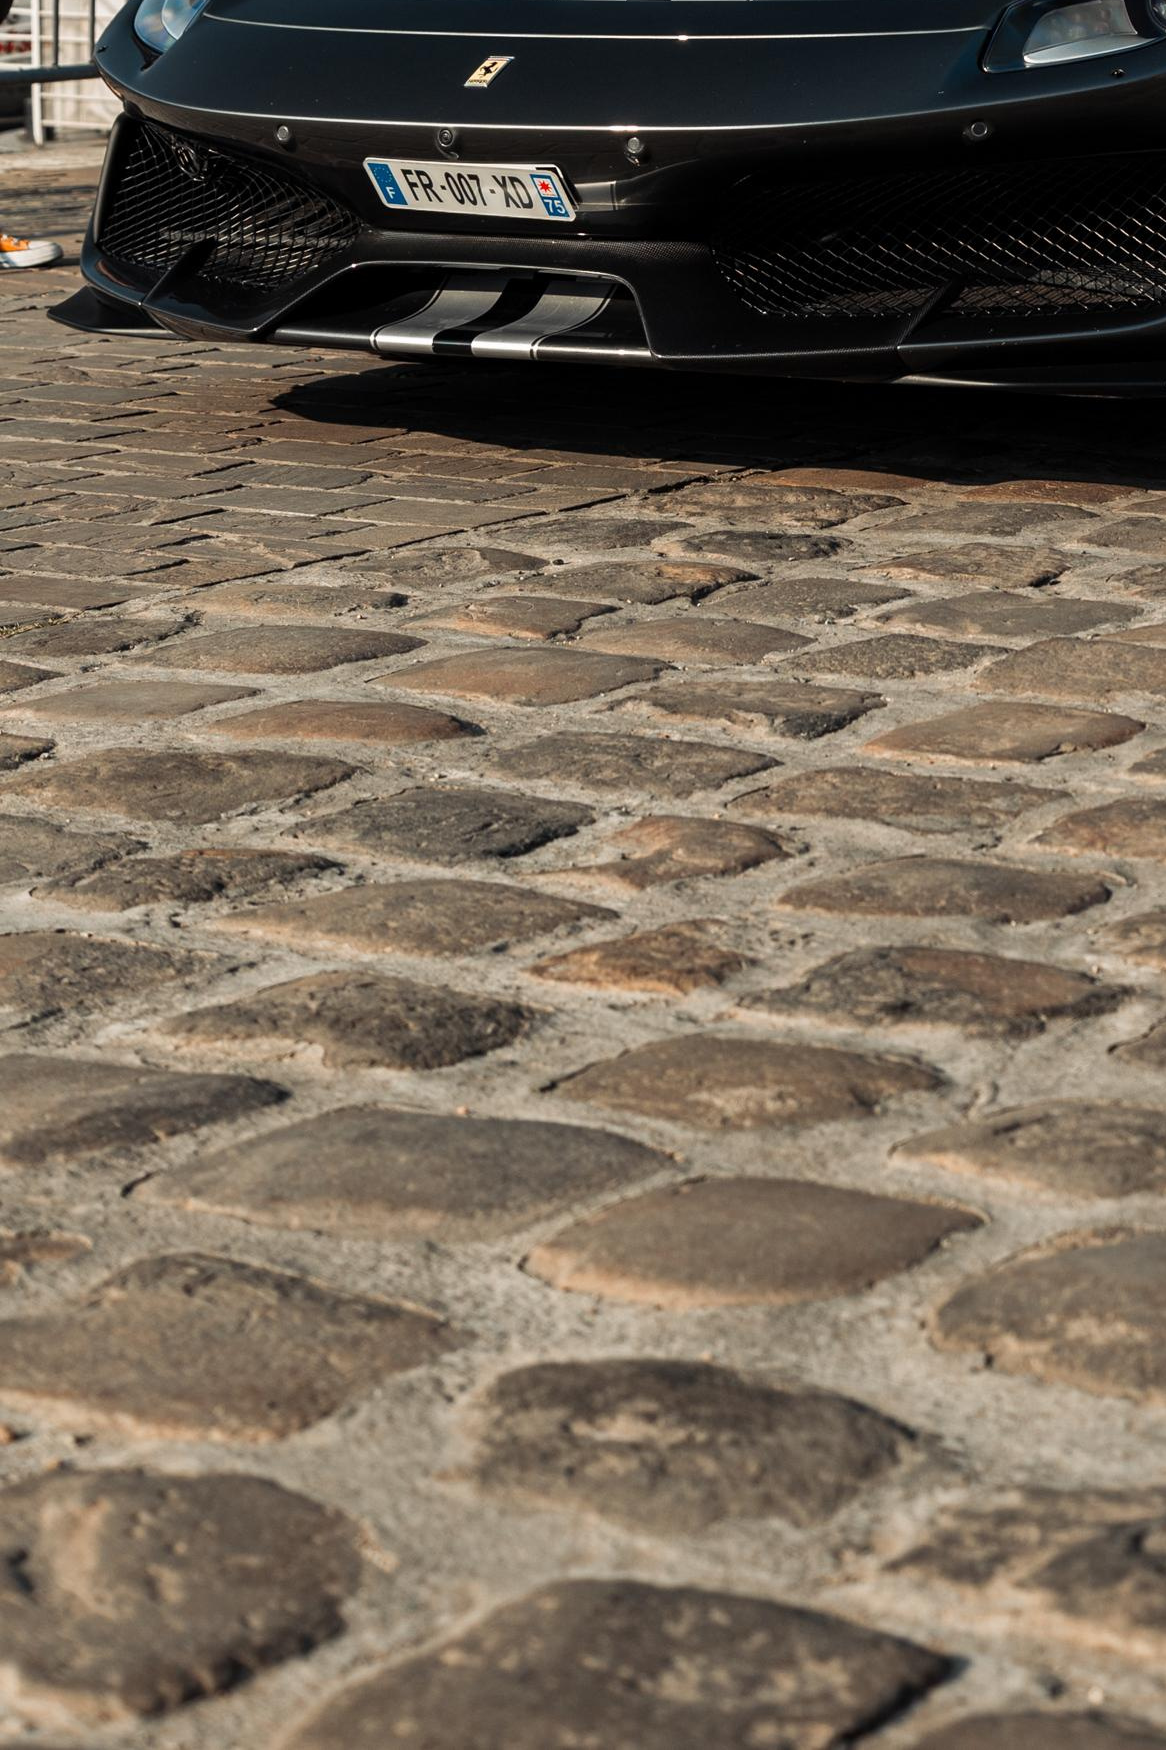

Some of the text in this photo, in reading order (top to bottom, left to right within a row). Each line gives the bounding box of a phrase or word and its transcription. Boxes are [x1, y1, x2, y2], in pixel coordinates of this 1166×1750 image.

[385, 186, 396, 199] F
[400, 168, 534, 209] FR-007-XD
[543, 199, 566, 214] 75
